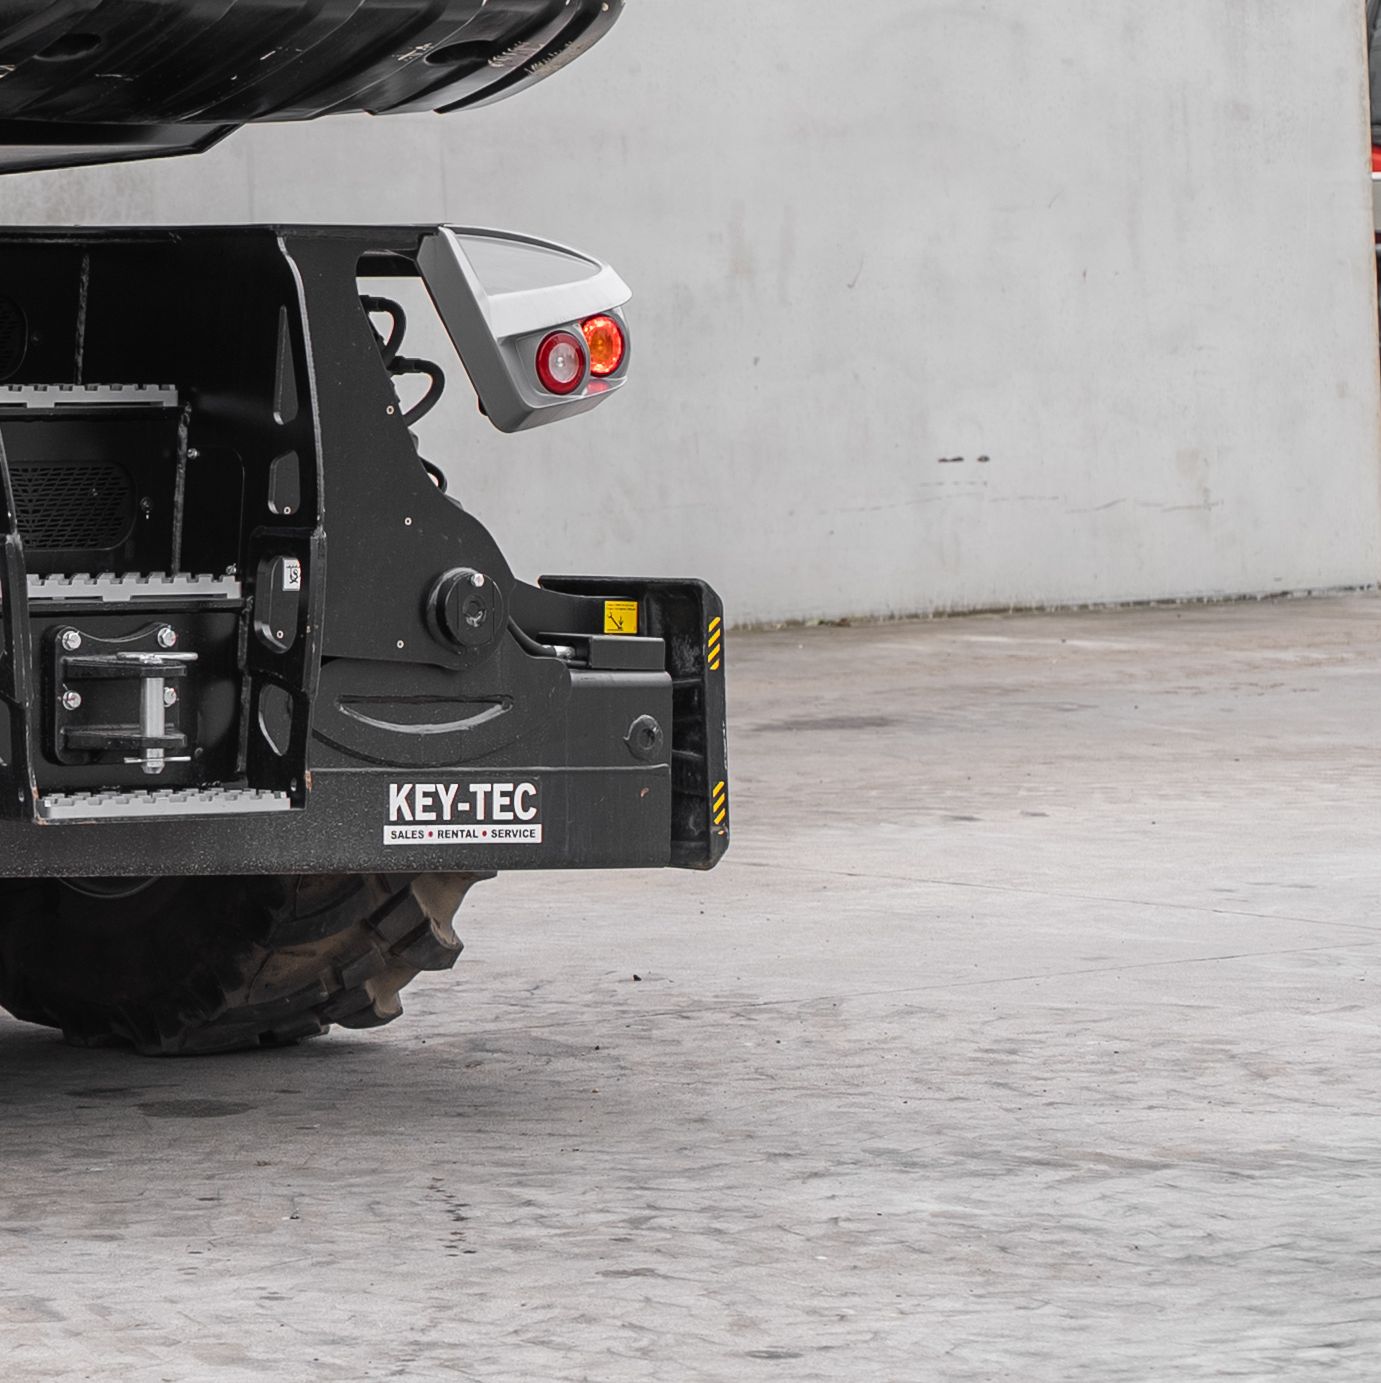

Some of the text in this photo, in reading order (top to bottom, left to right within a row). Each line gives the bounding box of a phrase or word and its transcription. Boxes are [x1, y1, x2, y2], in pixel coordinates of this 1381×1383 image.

[389, 782, 537, 821] KEY-TEC
[391, 828, 536, 839] SALES RENTAL SERVICE
